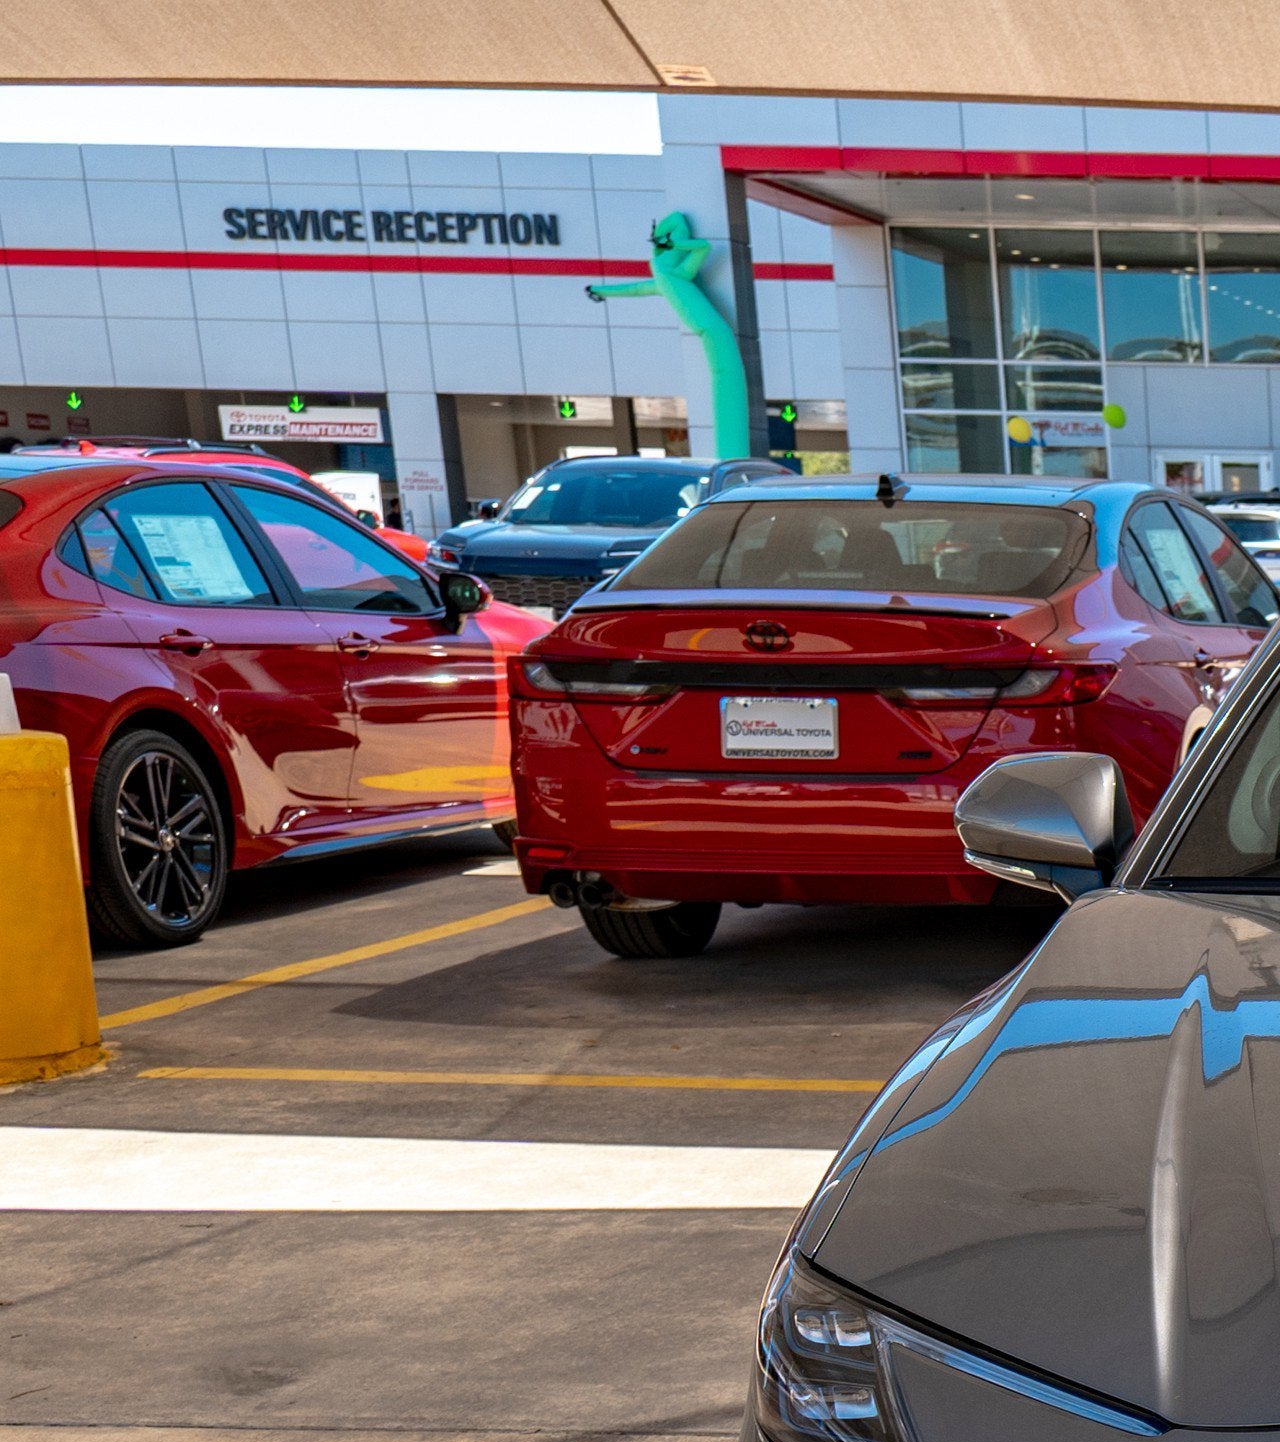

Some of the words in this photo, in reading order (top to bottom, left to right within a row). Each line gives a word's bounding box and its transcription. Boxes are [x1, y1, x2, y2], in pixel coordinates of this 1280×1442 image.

[222, 207, 366, 242] SERVICE
[371, 209, 560, 246] RECEPTION
[250, 414, 287, 422] TOYOTA
[229, 424, 288, 435] EXPRESS
[290, 424, 377, 437] MAINTENANCE
[742, 728, 795, 737] UNIVERSAL
[796, 729, 832, 737] TOYOTA
[725, 748, 835, 758] UNIVERSALTOYOTA.COM
